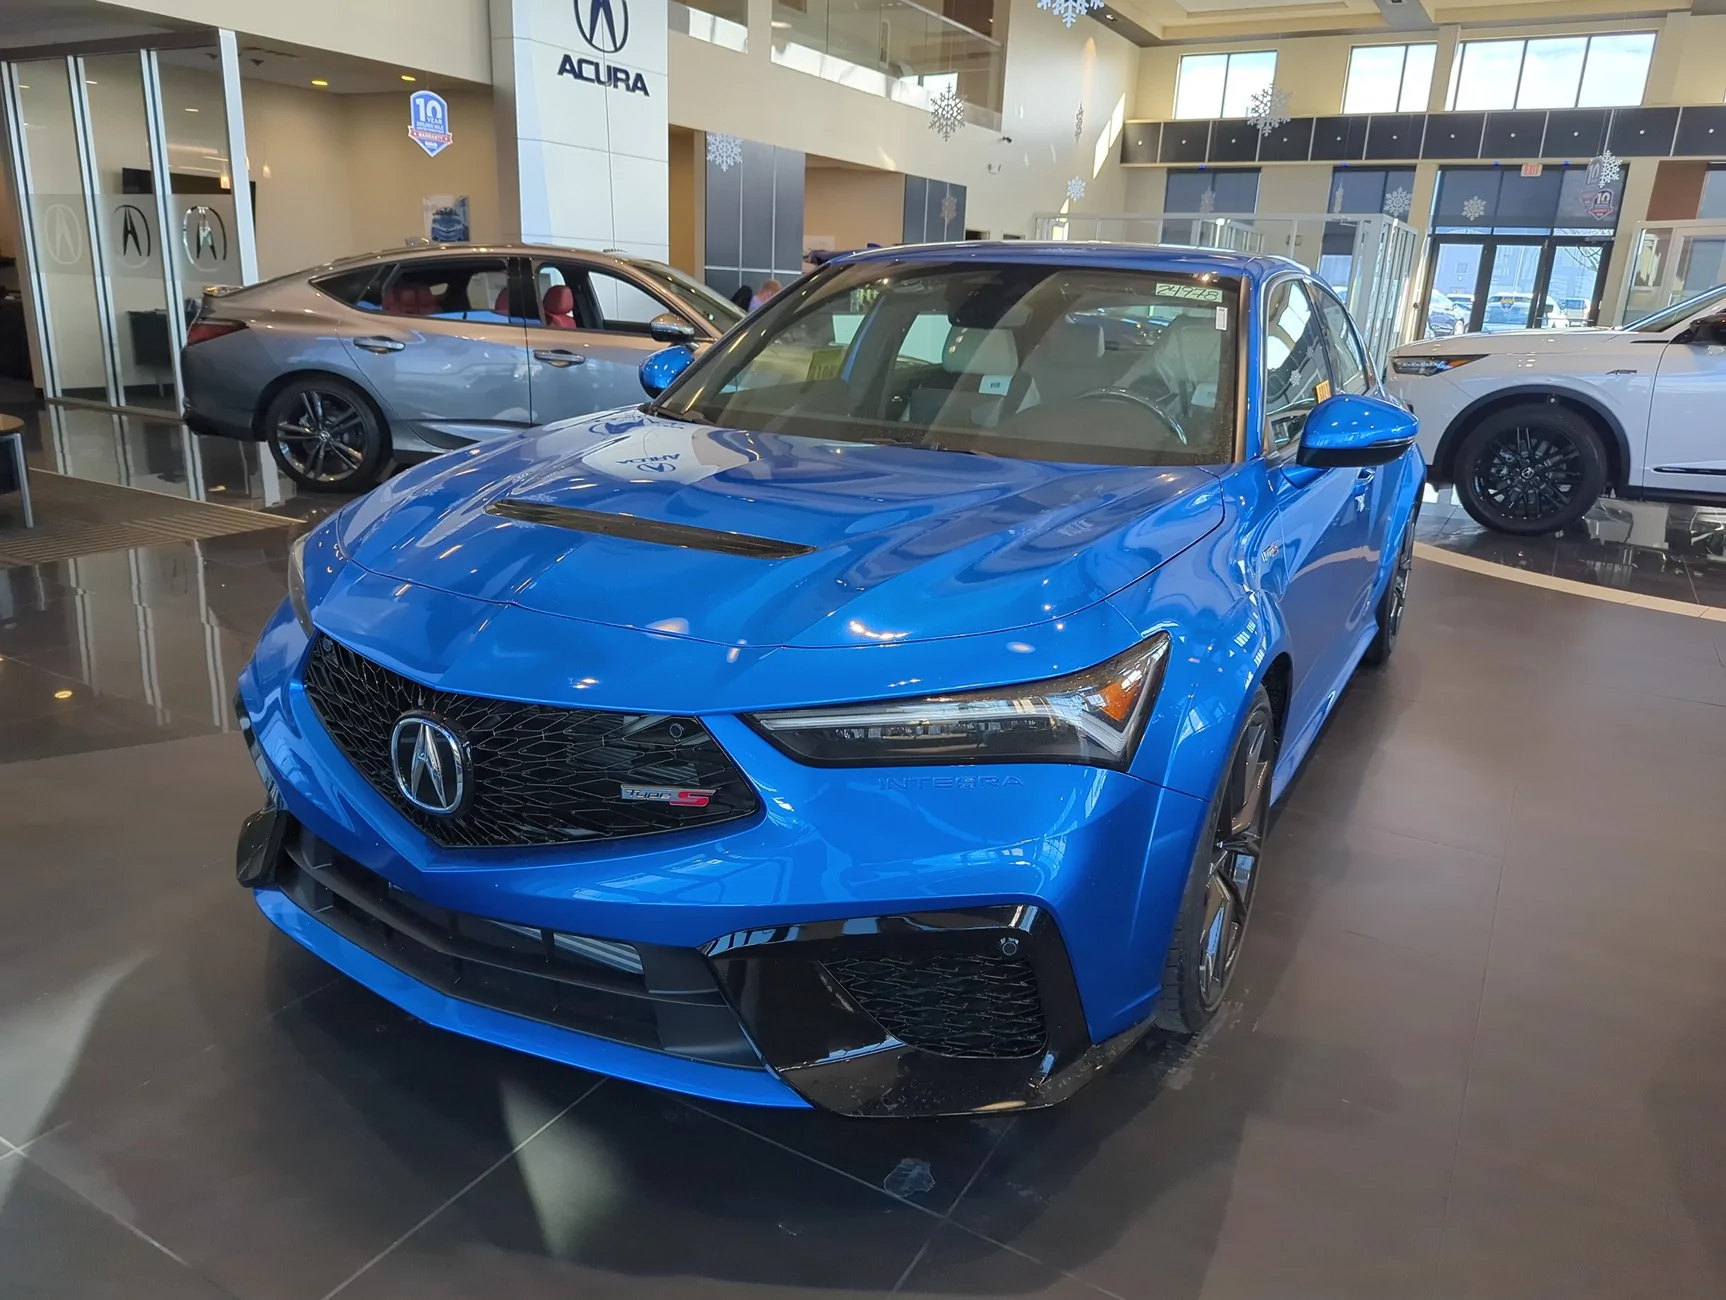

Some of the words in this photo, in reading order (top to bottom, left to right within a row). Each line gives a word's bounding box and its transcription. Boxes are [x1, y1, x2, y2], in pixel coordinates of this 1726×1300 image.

[557, 53, 650, 97] ACURA
[415, 98, 443, 122] 10
[1524, 164, 1541, 175] EXIT
[1157, 284, 1219, 301] 24978
[878, 775, 1025, 790] INTEGRA
